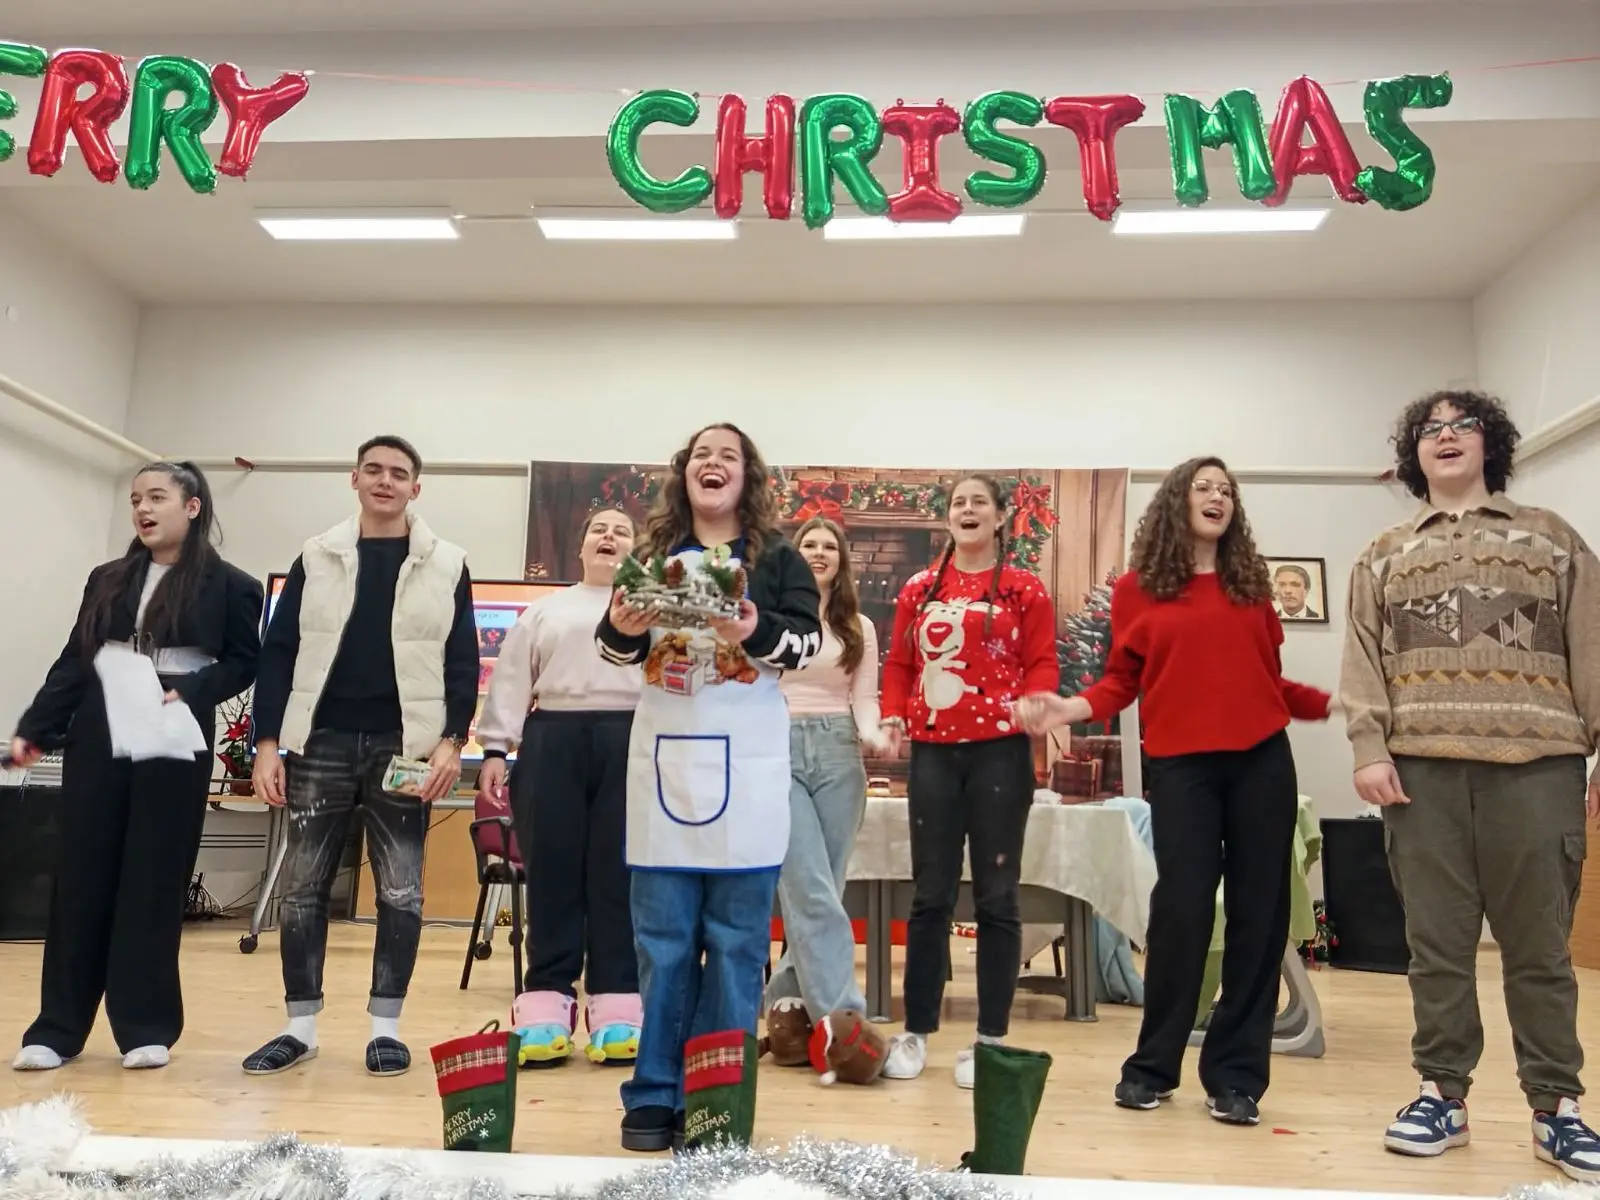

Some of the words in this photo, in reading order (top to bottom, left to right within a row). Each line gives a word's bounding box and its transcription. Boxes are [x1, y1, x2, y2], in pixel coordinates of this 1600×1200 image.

[606, 74, 1453, 229] CHRISTMAS
[445, 1108, 497, 1148] HRISTMAS
[684, 1110, 731, 1144] HRISTMAS
